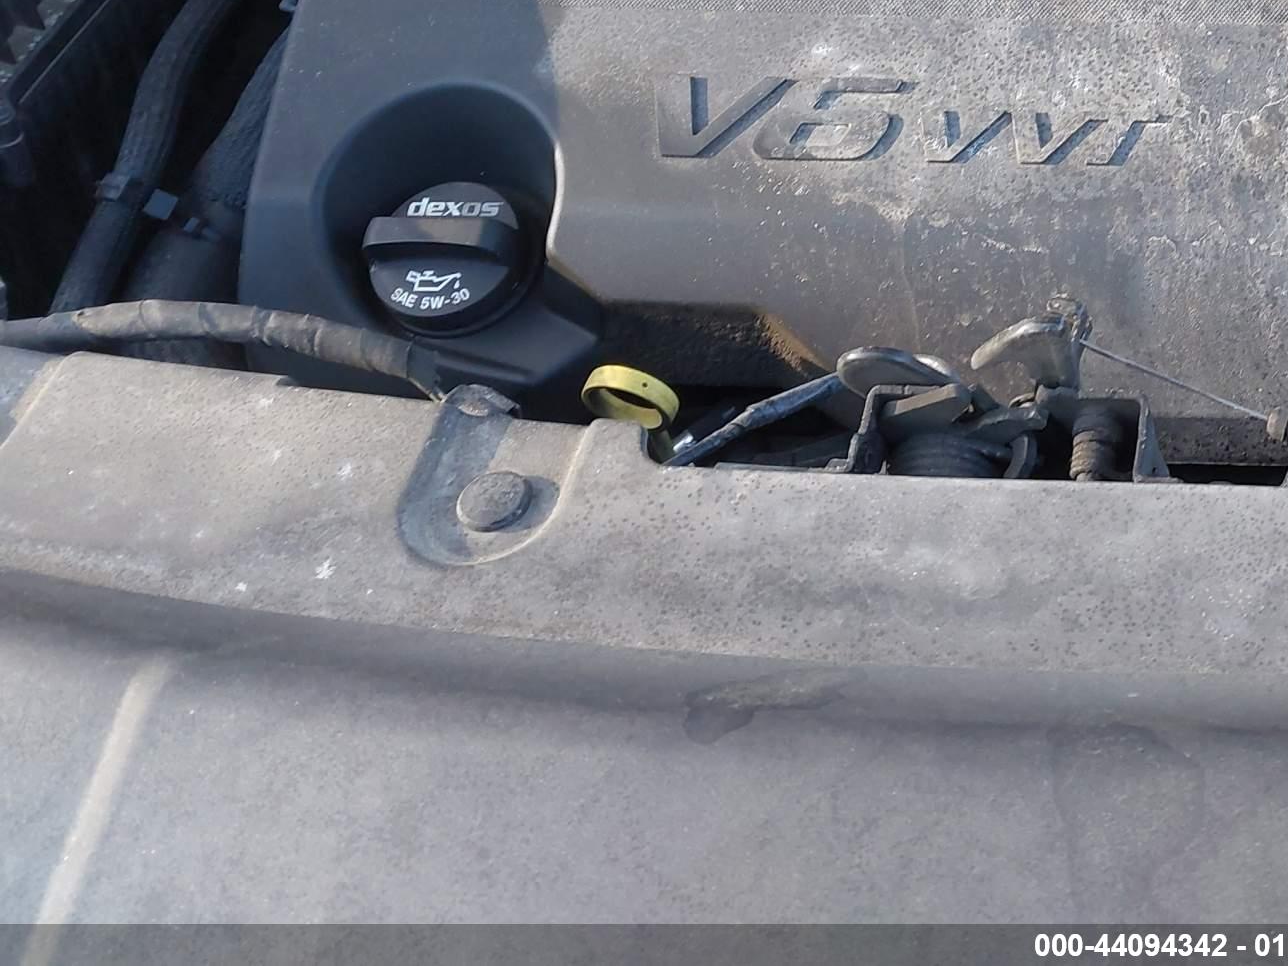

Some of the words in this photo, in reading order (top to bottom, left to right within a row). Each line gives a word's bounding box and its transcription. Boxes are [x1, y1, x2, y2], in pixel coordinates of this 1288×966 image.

[655, 76, 915, 161] V6
[922, 110, 1172, 165] VVT
[407, 197, 505, 218] dexos
[391, 288, 419, 309] SAE
[419, 288, 471, 310] 5W-30
